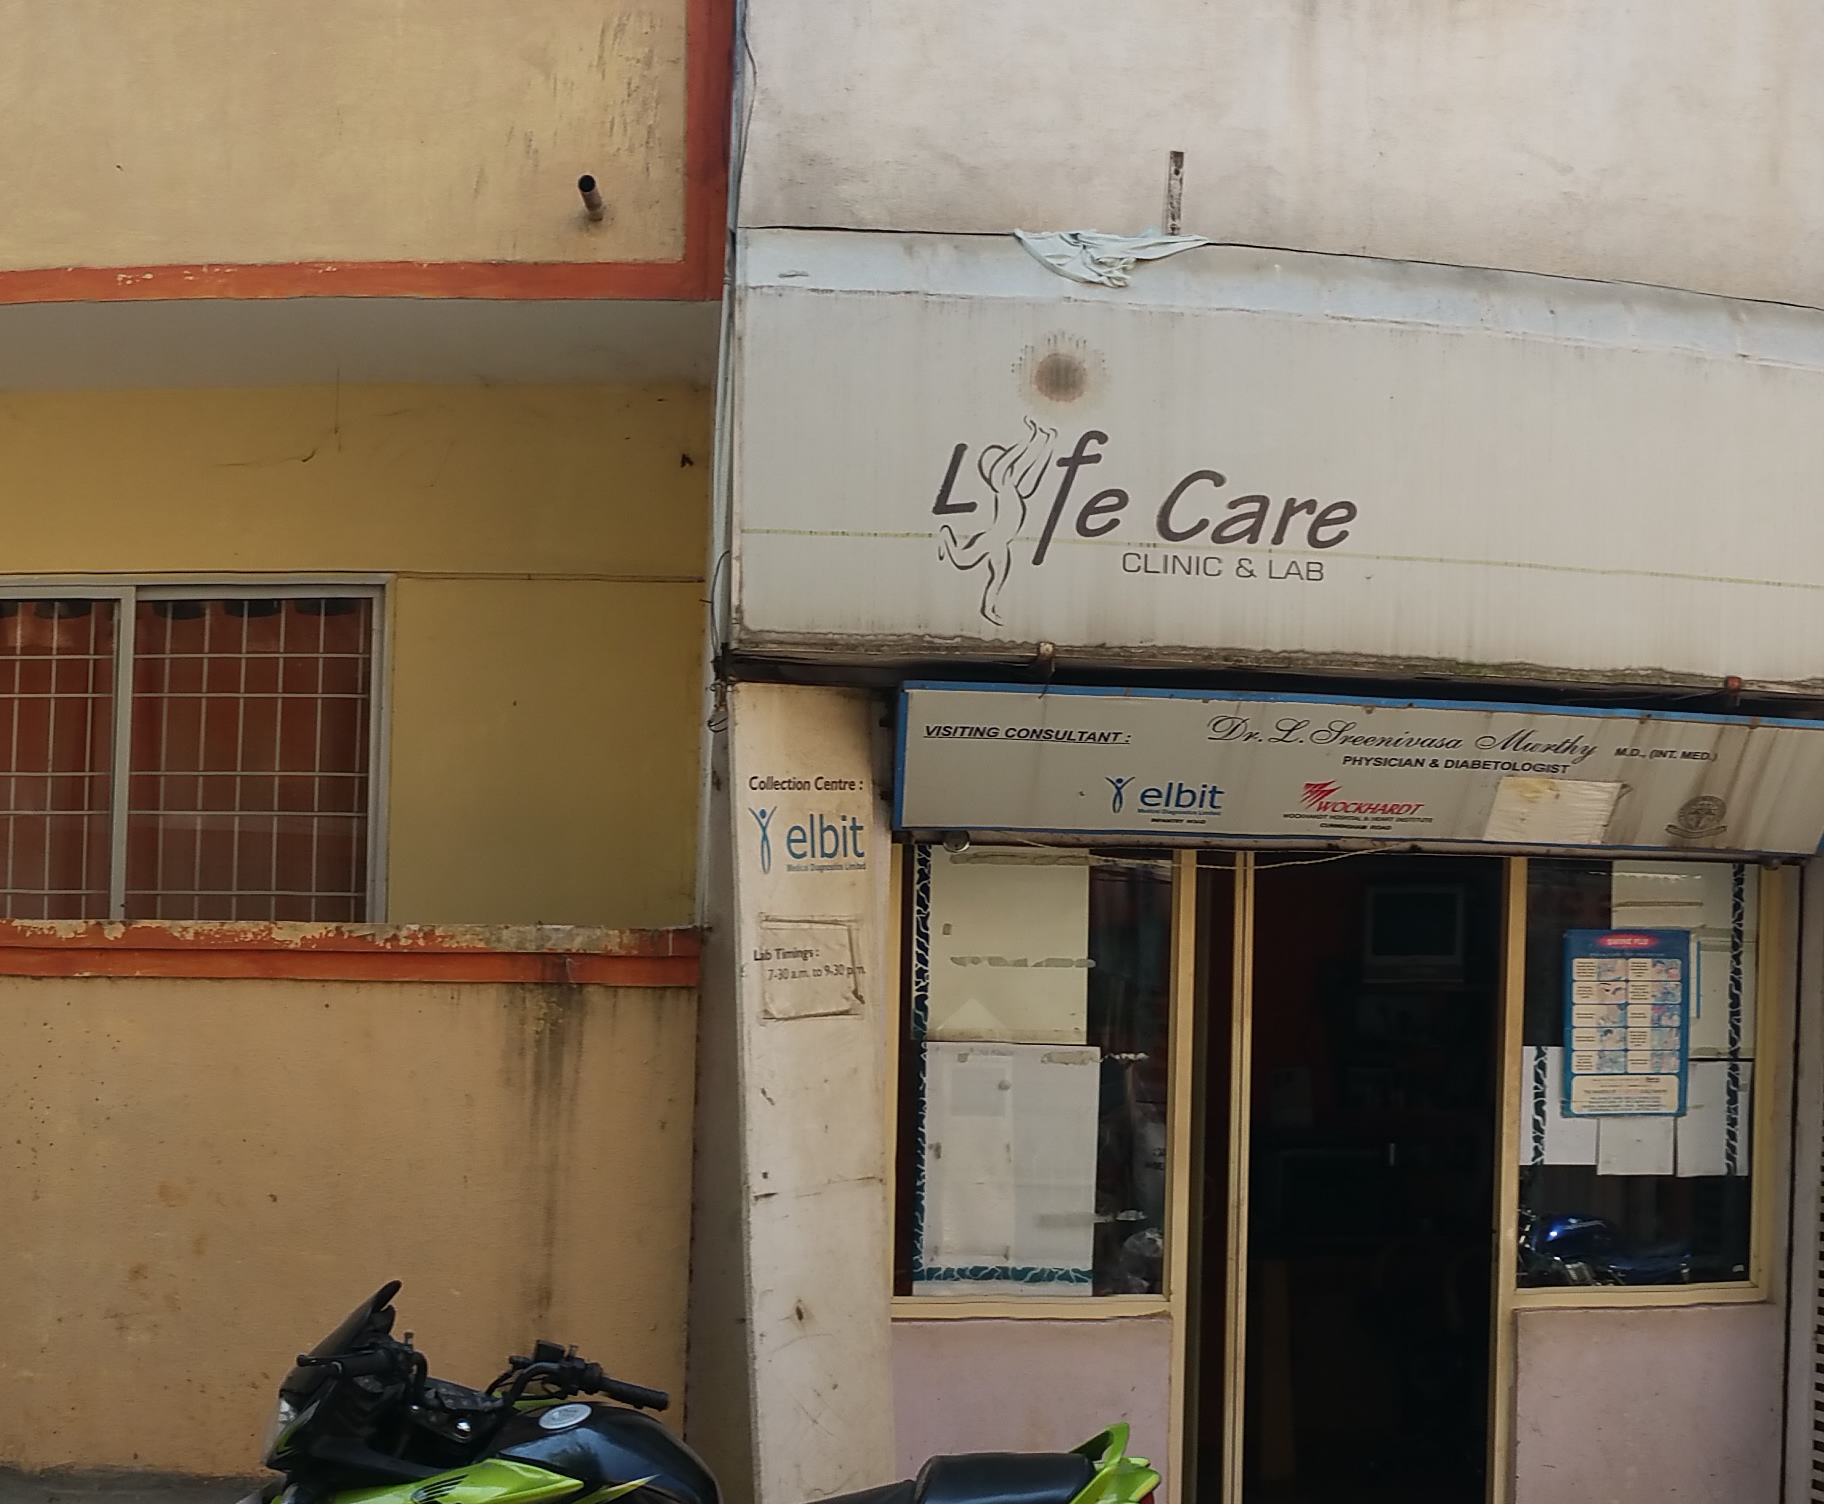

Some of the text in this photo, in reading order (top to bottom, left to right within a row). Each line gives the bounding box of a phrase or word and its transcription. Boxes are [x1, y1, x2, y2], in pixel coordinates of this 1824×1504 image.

[1155, 469, 1357, 548] Care
[1121, 552, 1325, 583] CLINIC & LAB
[925, 725, 1122, 743] VISITING CONSULTANT
[1207, 716, 1263, 743] Dr.
[1268, 718, 1310, 744] L.
[1310, 720, 1463, 749] Sreenivasa
[1475, 729, 1597, 764] Murthy
[1342, 755, 1570, 774] PHYSICIAN & DIABETOLOGIST
[748, 776, 856, 791] Collection Centre
[1139, 782, 1225, 810] elbit
[1317, 800, 1425, 815] WOCKHARDT
[786, 813, 865, 859] elbit
[753, 947, 813, 962] Lab Timings
[812, 967, 823, 978] to
